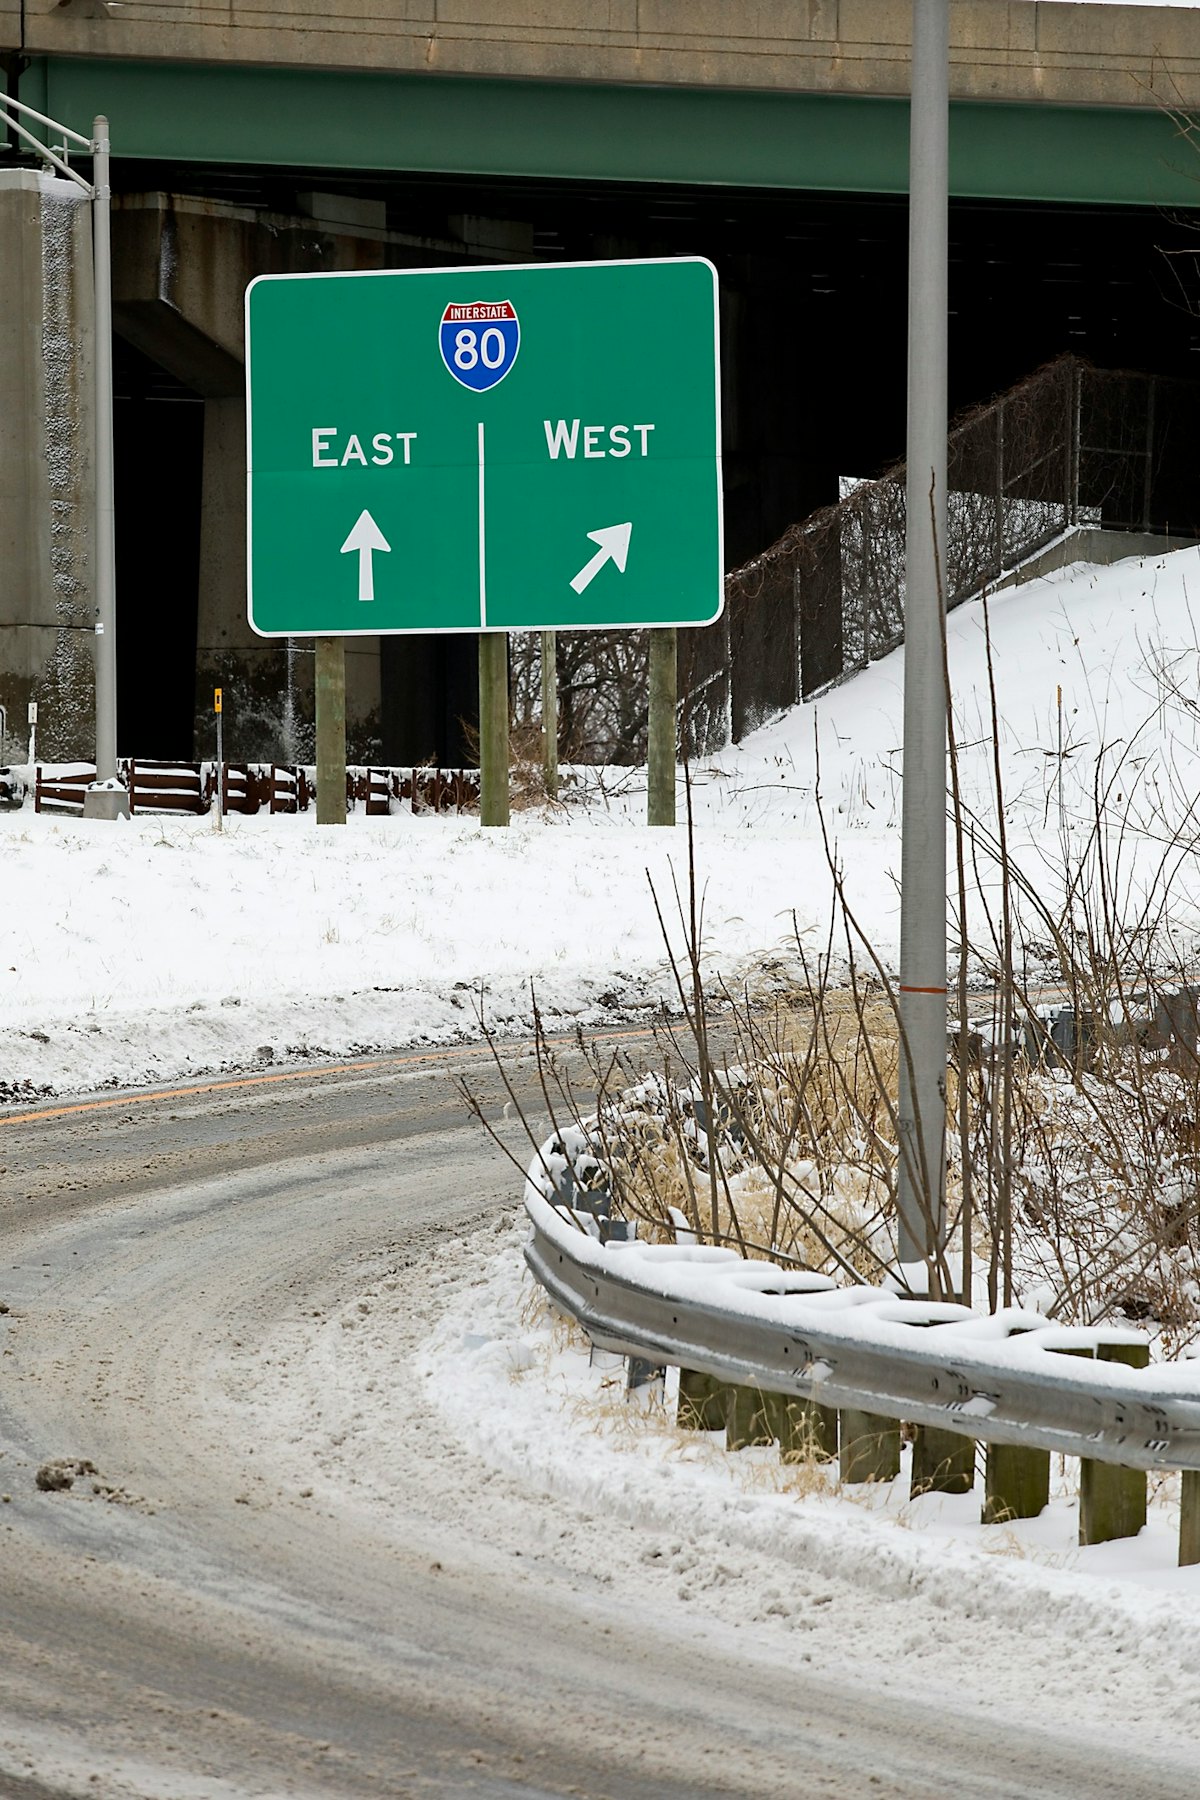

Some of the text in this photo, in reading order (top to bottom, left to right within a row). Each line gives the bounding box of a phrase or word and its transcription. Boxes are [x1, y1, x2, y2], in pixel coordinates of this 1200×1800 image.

[450, 305, 508, 319] INTERSTATE
[453, 327, 506, 370] 80
[311, 427, 417, 467] EAST
[543, 419, 655, 460] WEST
